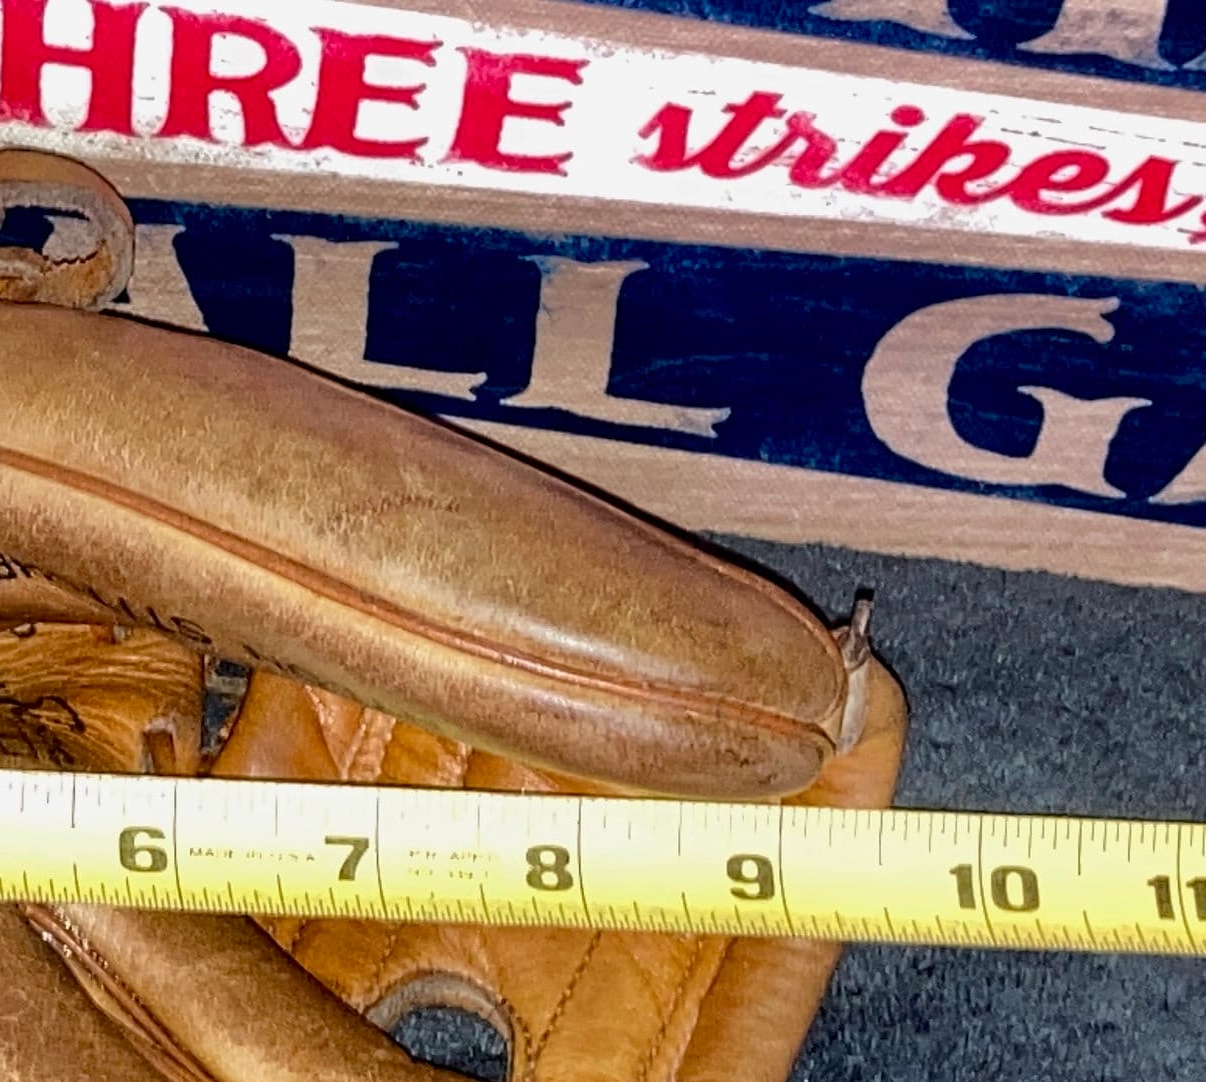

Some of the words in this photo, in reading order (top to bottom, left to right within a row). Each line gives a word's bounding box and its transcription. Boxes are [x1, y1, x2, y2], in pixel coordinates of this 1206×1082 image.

[118, 825, 168, 873] 6
[323, 835, 370, 882] 7
[524, 844, 574, 891] 8
[725, 853, 776, 900] 9
[948, 862, 1041, 913] 10
